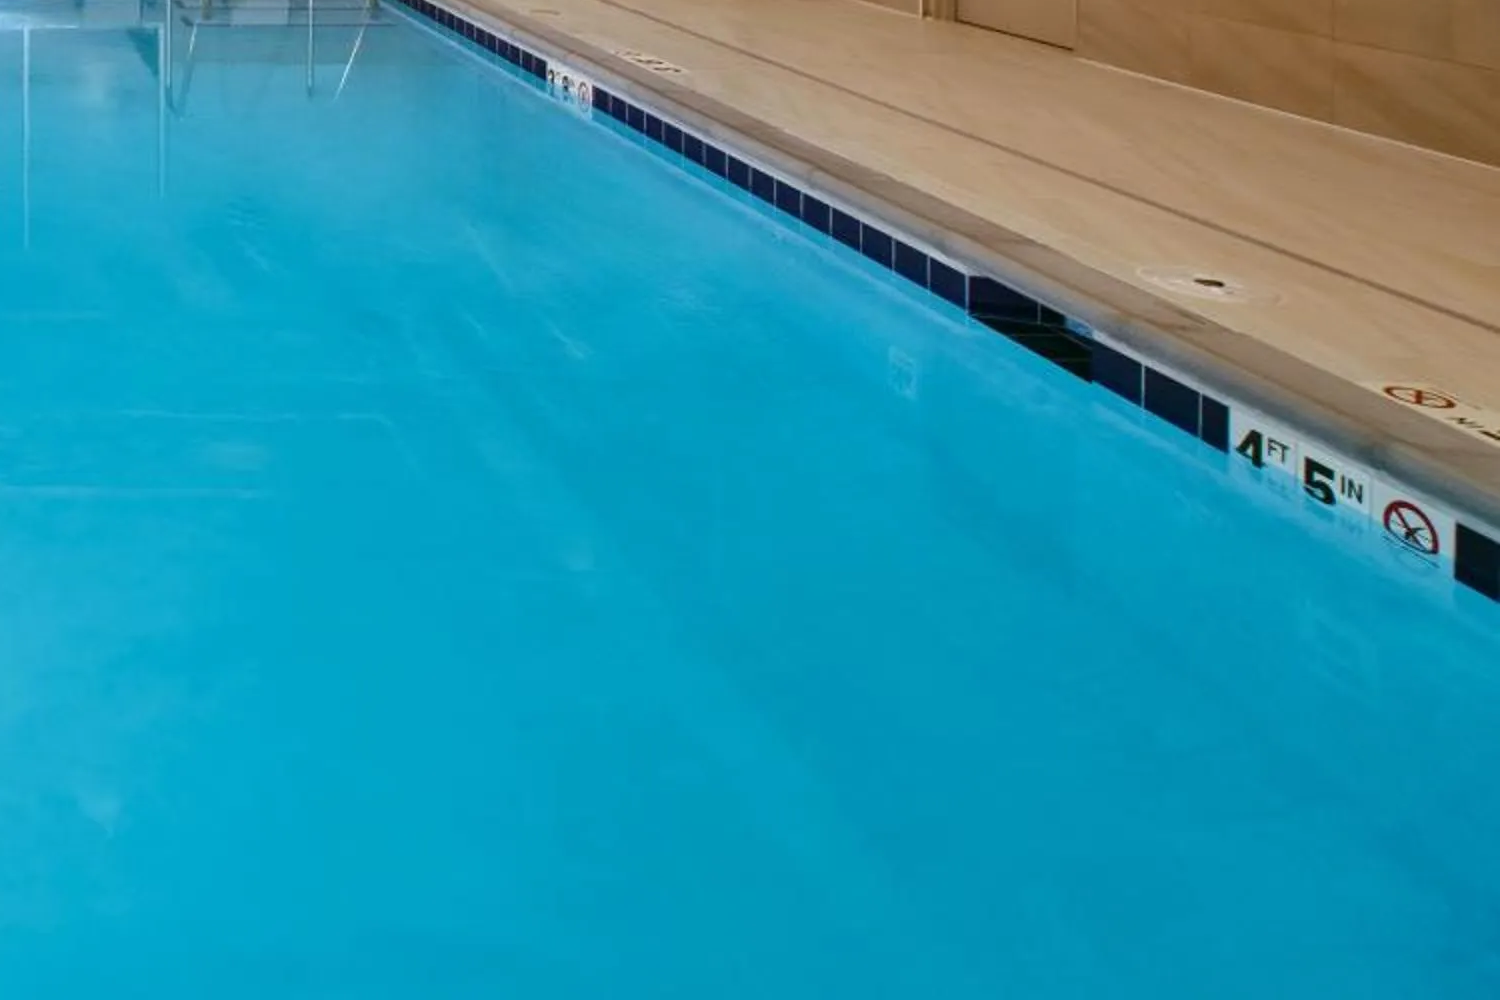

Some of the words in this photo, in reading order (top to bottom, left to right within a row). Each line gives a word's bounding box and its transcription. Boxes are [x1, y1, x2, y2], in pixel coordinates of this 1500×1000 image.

[1235, 429, 1267, 469] 4
[1267, 439, 1289, 464] FT
[1304, 456, 1337, 506] 5
[1340, 475, 1364, 504] IN
